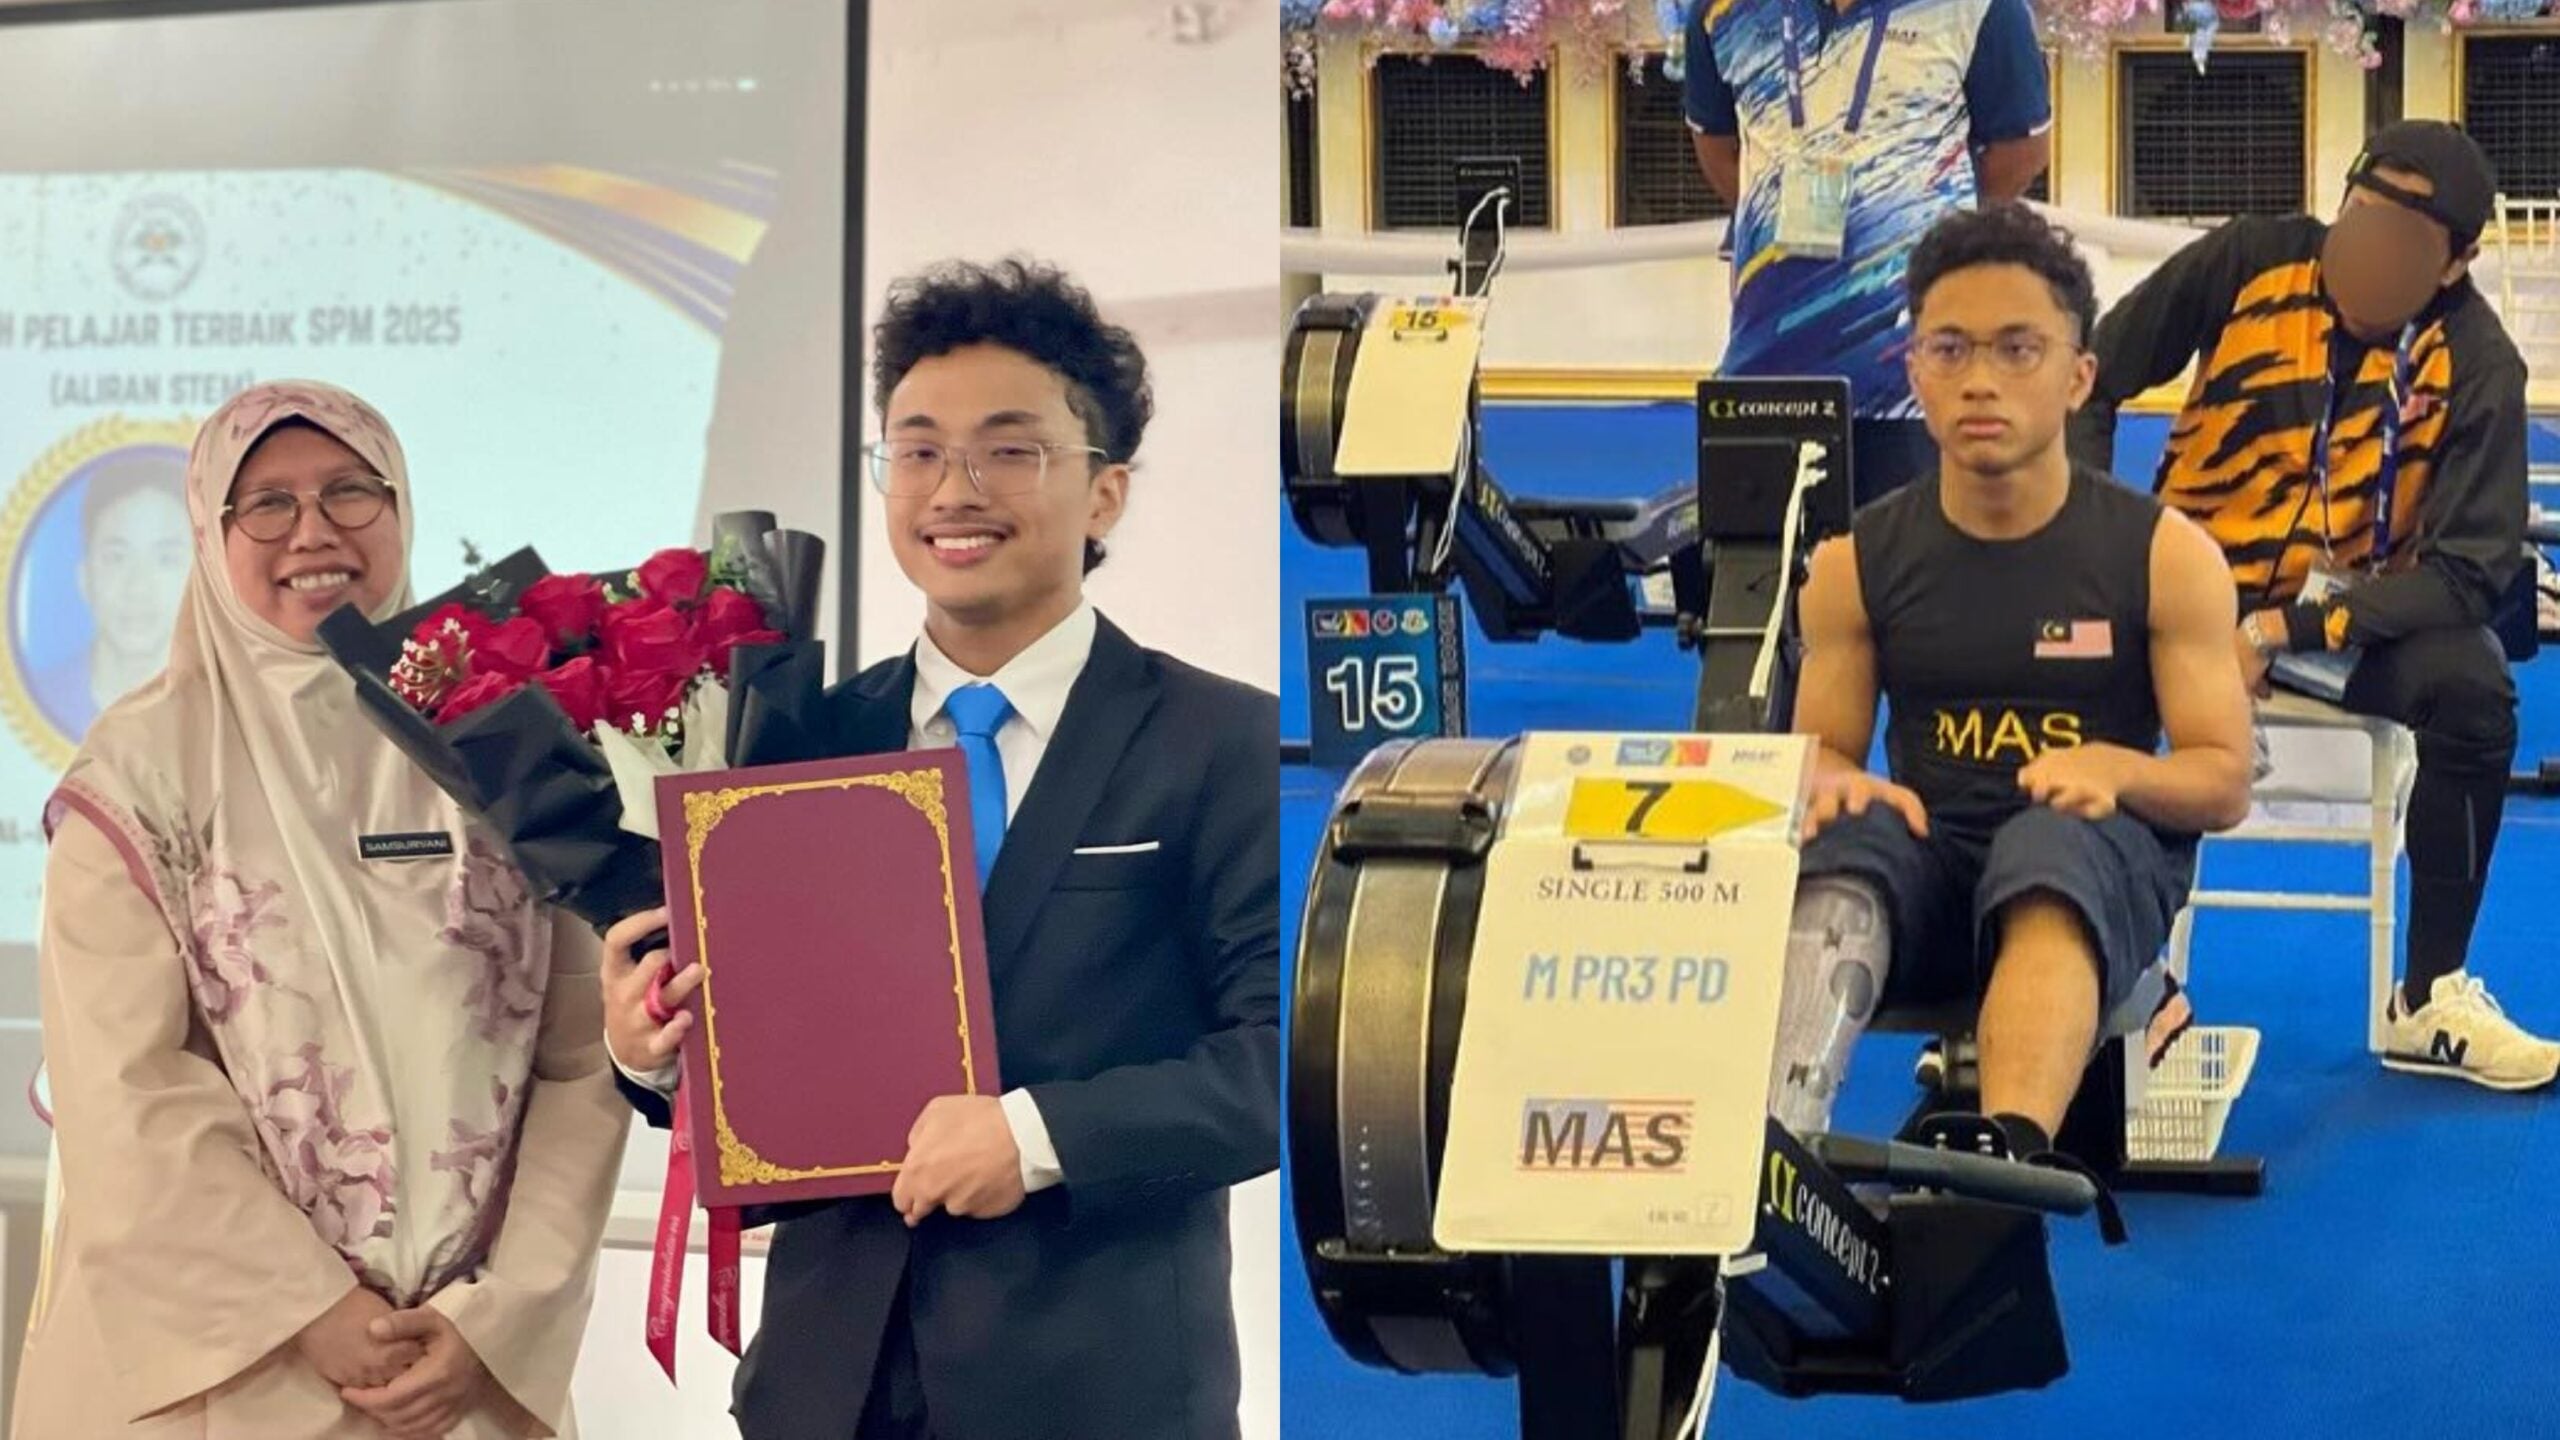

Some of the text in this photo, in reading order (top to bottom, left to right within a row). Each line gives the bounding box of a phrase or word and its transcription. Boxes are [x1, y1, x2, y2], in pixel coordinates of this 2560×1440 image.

[24, 311, 160, 349] PELAJAR
[172, 309, 296, 347] TERBAIK
[308, 305, 374, 346] SPM
[382, 303, 461, 346] 2025
[1406, 311, 1438, 329] 15
[51, 370, 160, 407] (ALIRAN
[1739, 401, 1817, 417] concept
[1327, 656, 1422, 731] 15
[1937, 708, 2081, 759] MAS
[1626, 781, 1671, 832] 7
[1537, 878, 1740, 904] SINGLE 500 M
[1524, 953, 1729, 1003] M PR3 PD
[1522, 1110, 1685, 1168] MAS
[1796, 1183, 1867, 1284] concept
